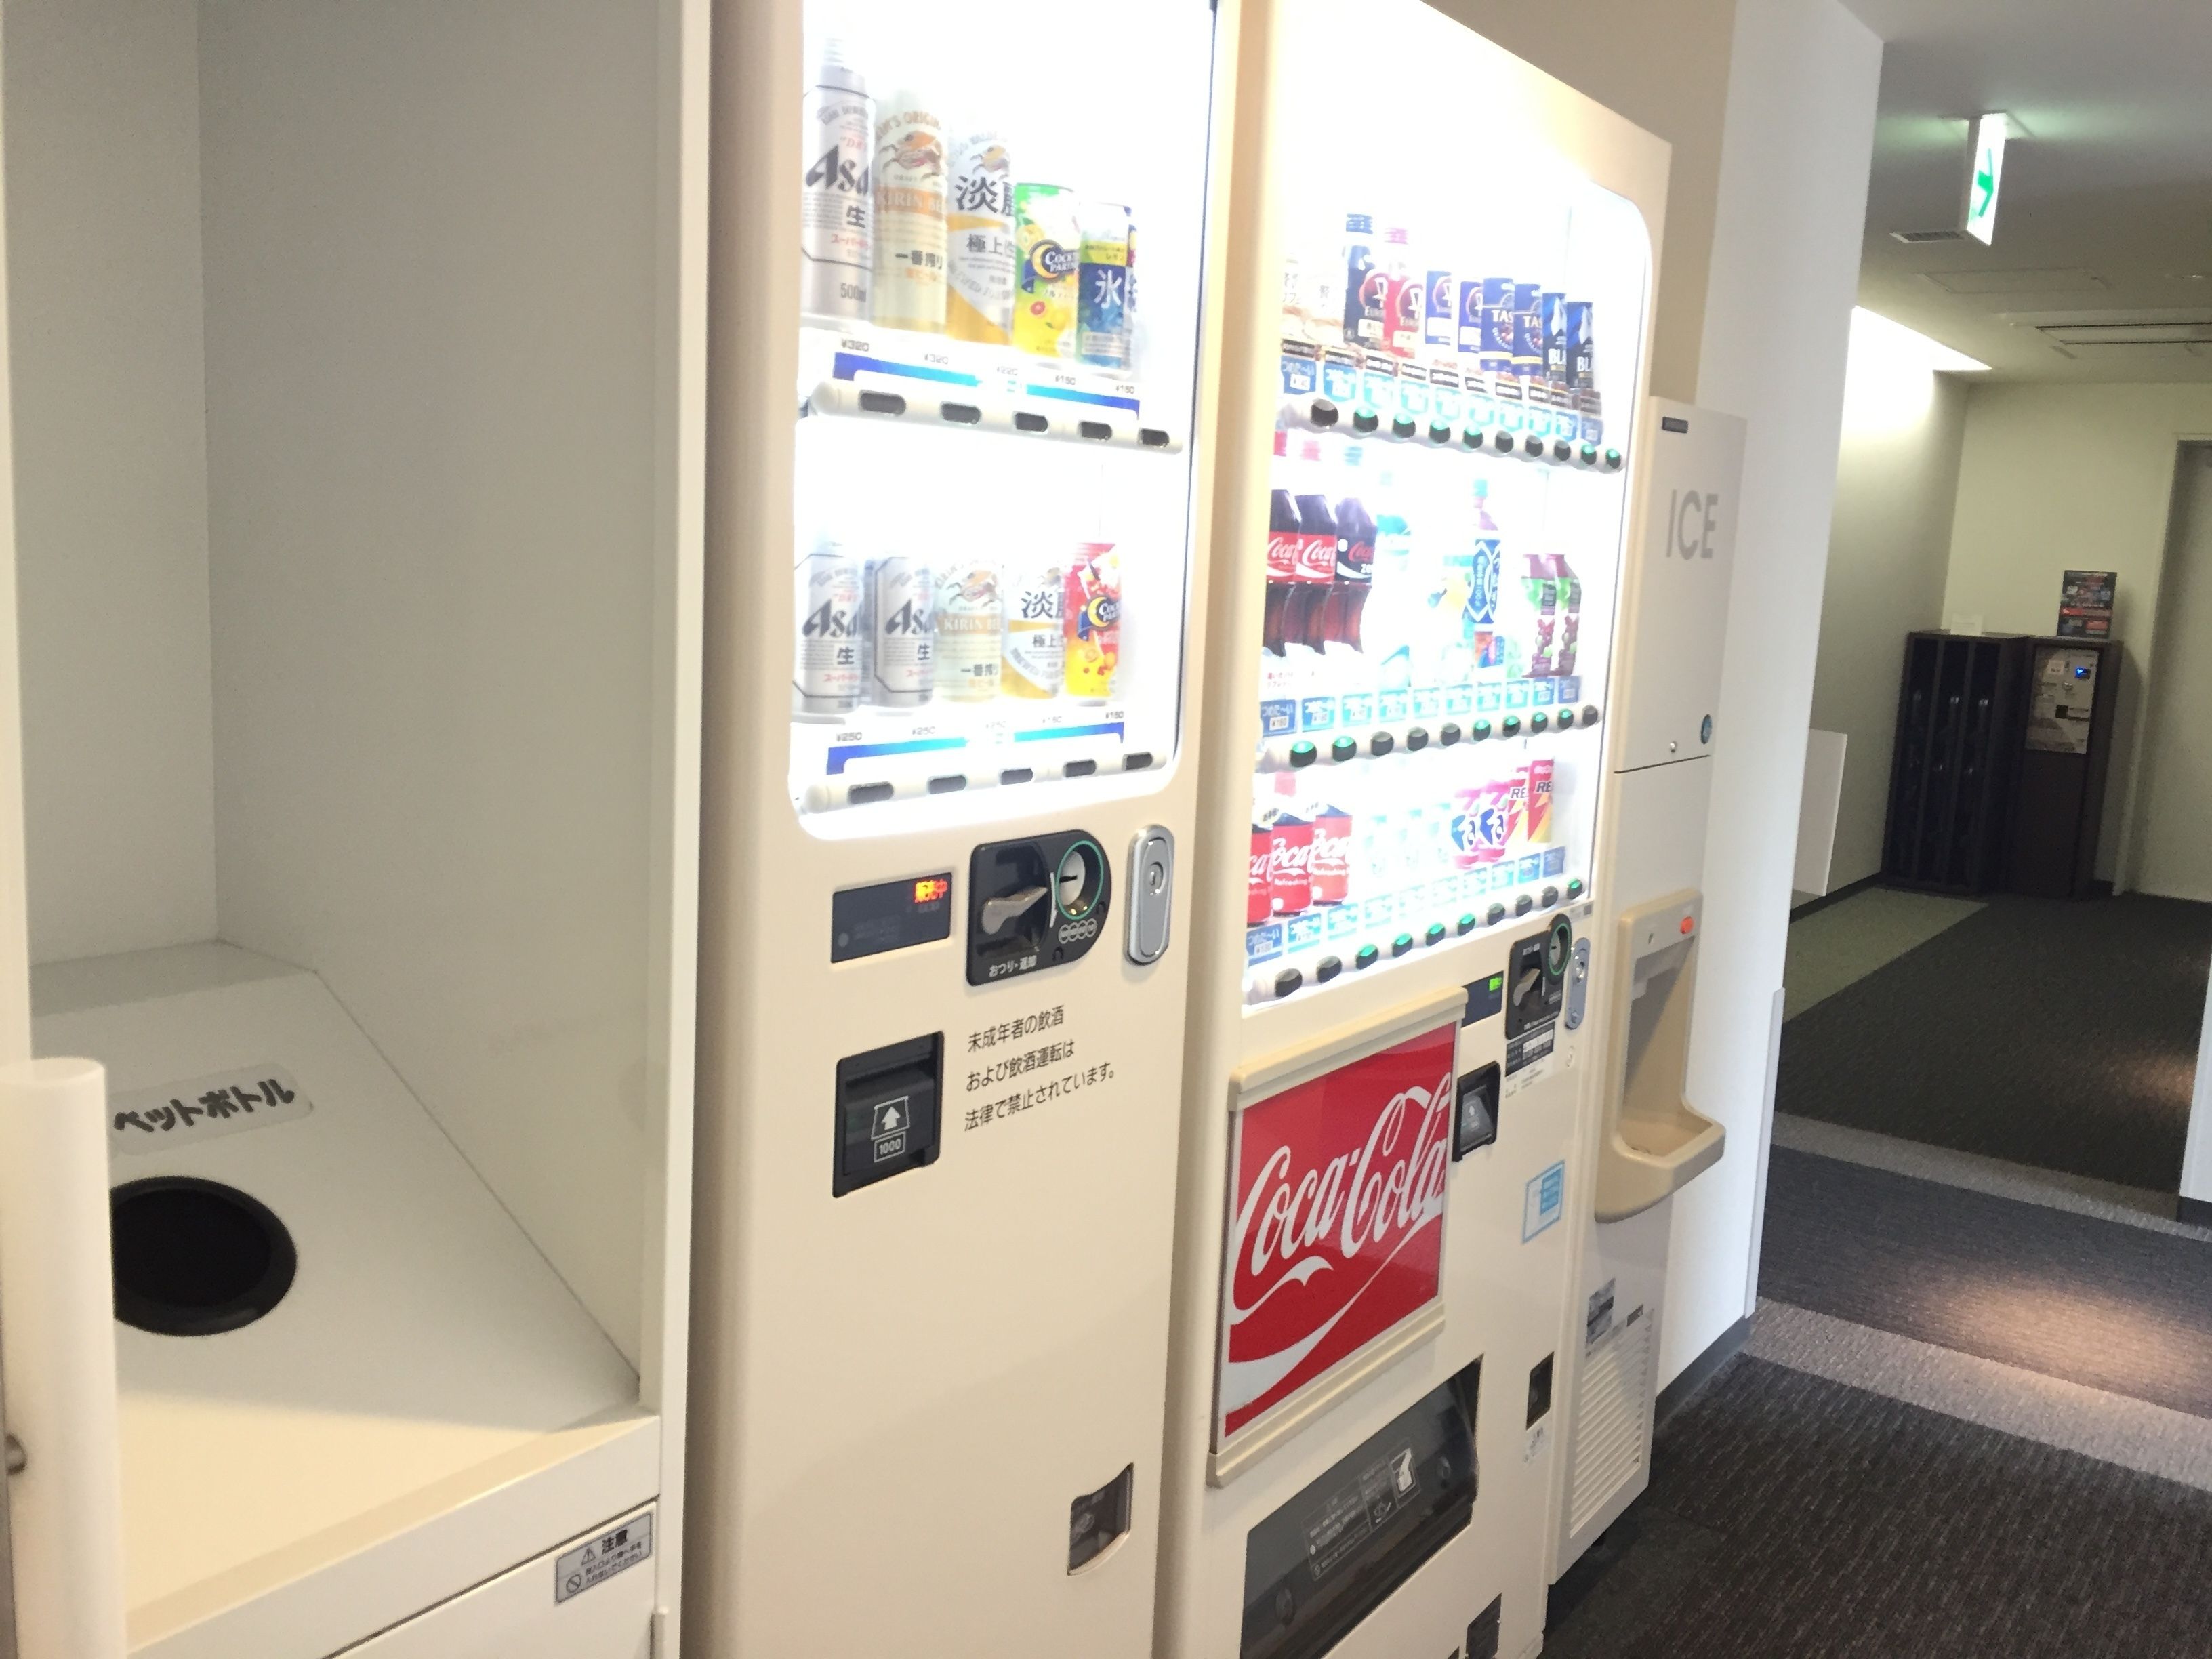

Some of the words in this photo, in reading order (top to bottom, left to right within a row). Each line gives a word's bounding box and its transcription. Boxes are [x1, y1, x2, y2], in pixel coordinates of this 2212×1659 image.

[845, 205, 867, 229] 生
[1666, 489, 1719, 560] ICE
[836, 646, 855, 665] 生
[917, 643, 931, 661] 生
[968, 1004, 1065, 1052] 未成年者の飲酒
[966, 1038, 1075, 1092] および飲酒運転は
[113, 1078, 296, 1133] ペットボトル
[964, 1061, 1115, 1132] 法律で禁止されています。
[878, 1137, 902, 1155] 1000
[1230, 1071, 1451, 1325] Coca-Cola
